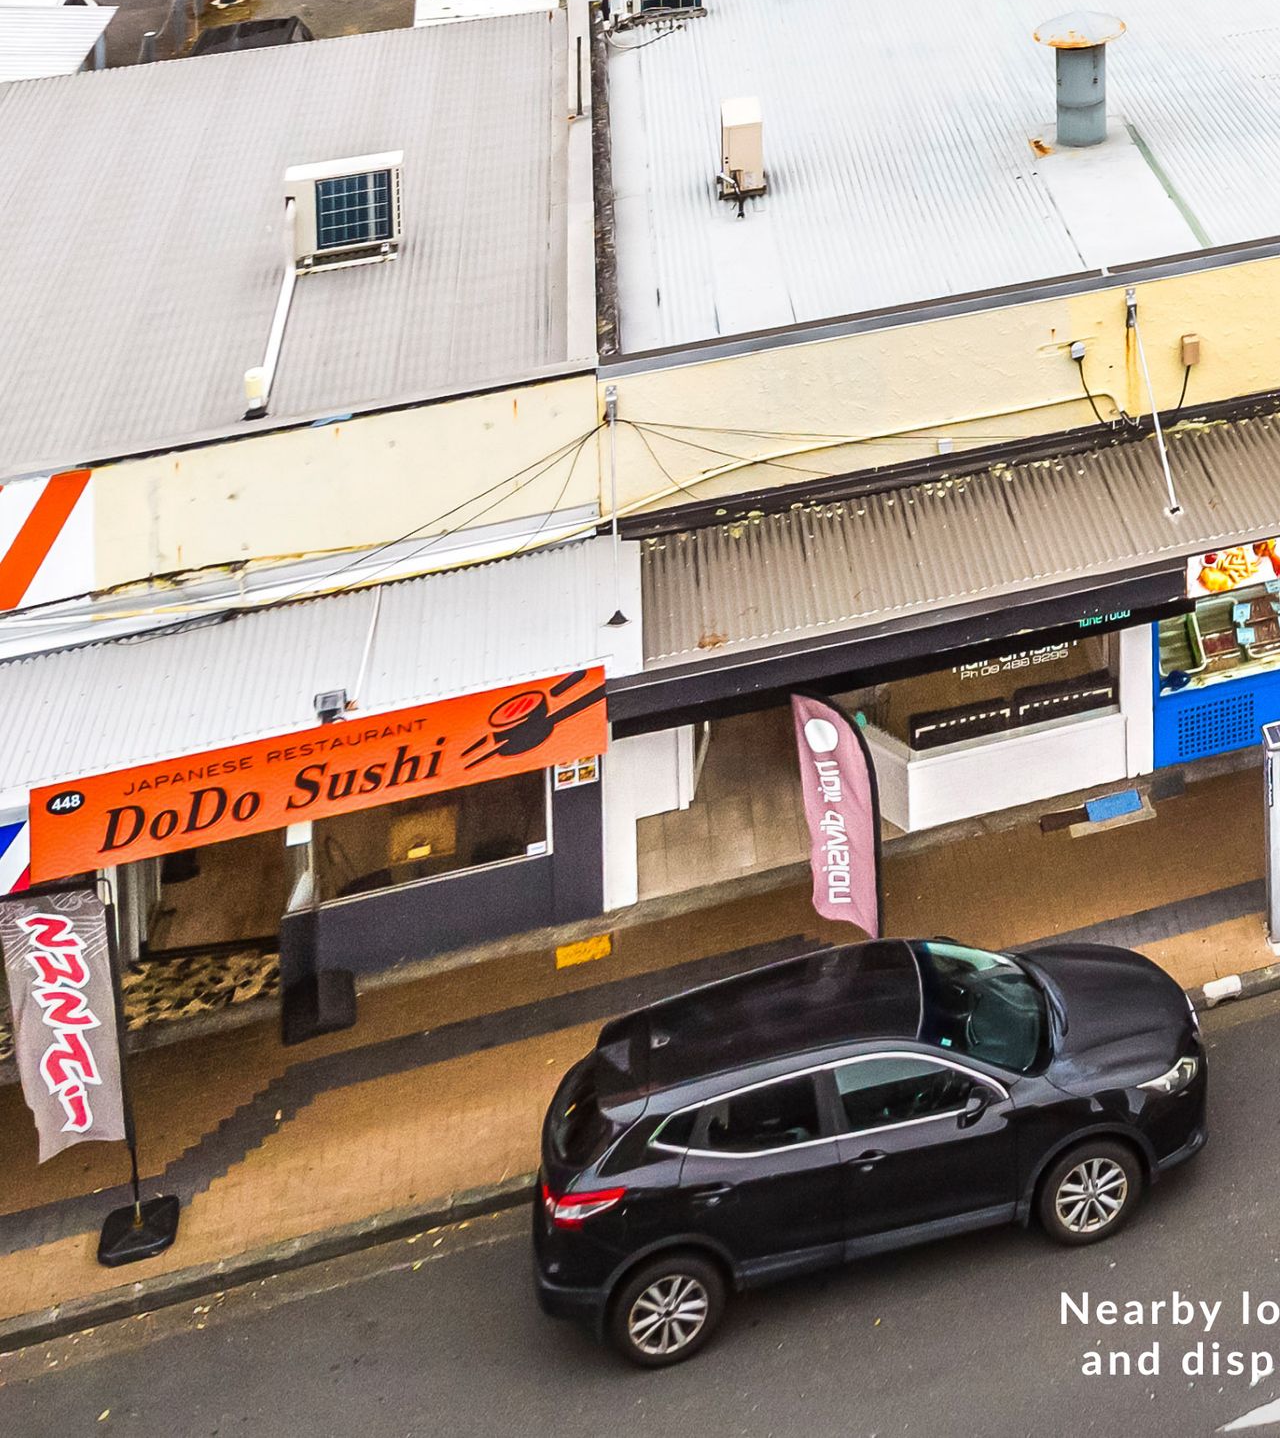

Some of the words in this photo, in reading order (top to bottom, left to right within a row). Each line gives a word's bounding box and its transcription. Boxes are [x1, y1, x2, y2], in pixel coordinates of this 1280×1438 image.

[960, 670, 978, 681] Ph
[981, 665, 1000, 676] 09
[123, 755, 254, 797] JAPANESE
[265, 717, 428, 765] RESTAURANT
[51, 792, 82, 811] 448
[97, 787, 261, 854] DoDo
[284, 736, 446, 813] Sushi
